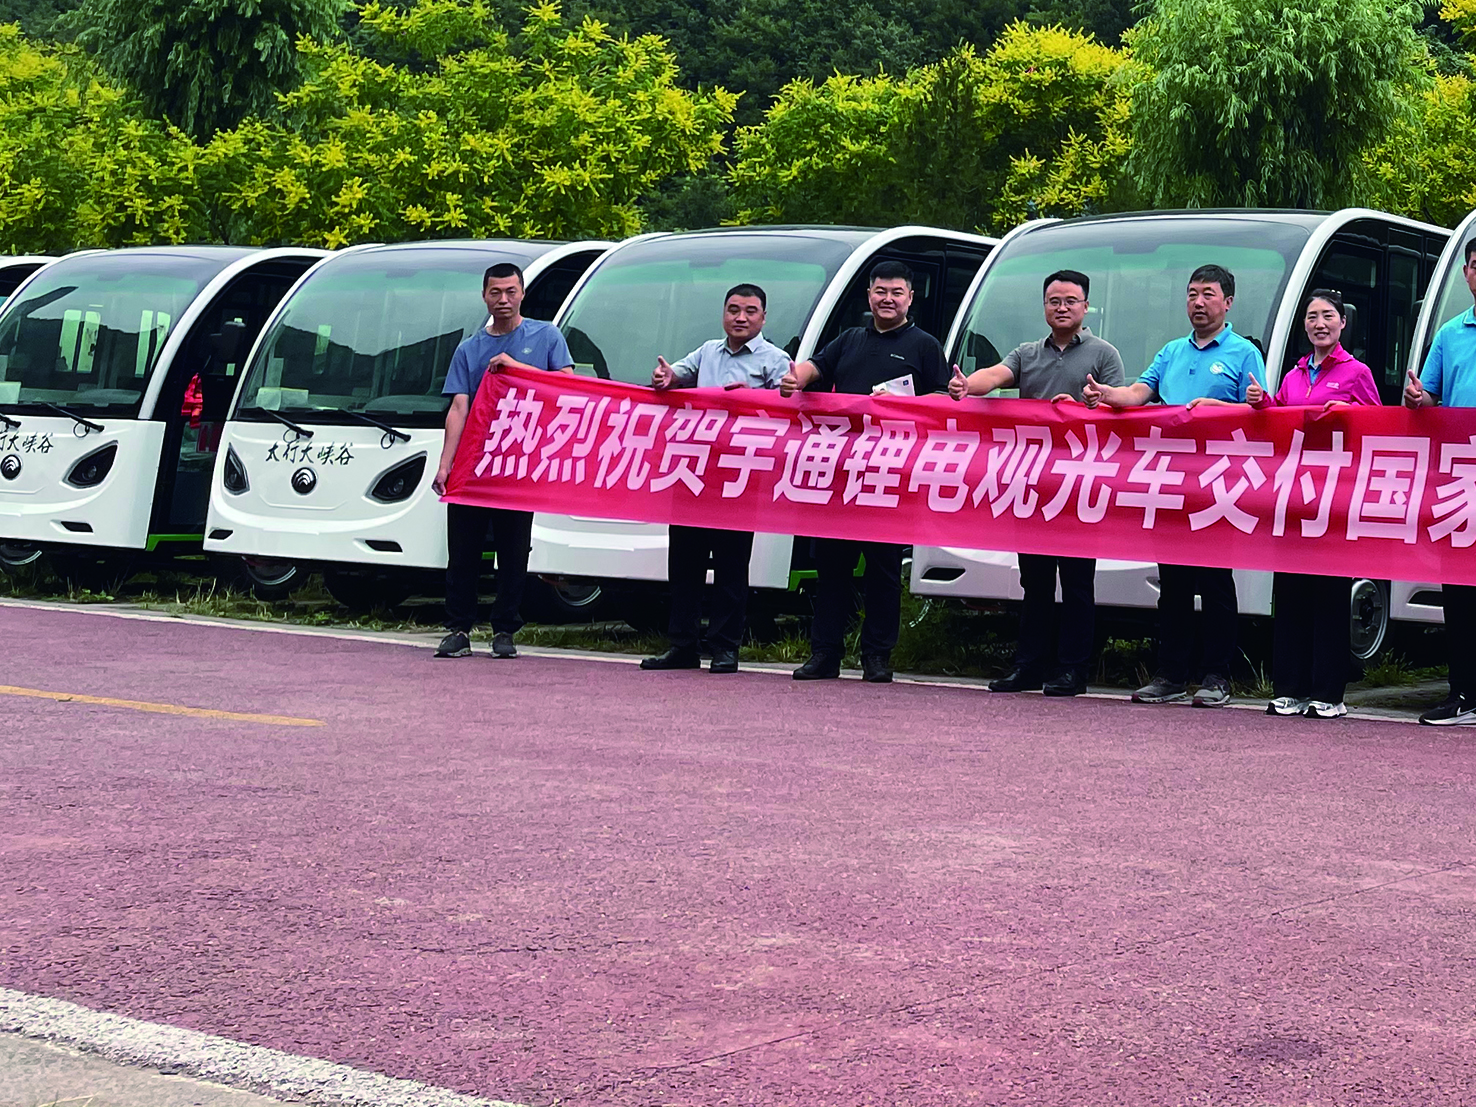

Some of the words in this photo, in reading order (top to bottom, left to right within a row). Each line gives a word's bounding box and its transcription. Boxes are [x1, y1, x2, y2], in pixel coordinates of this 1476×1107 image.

[265, 441, 355, 465] 太行大峡谷
